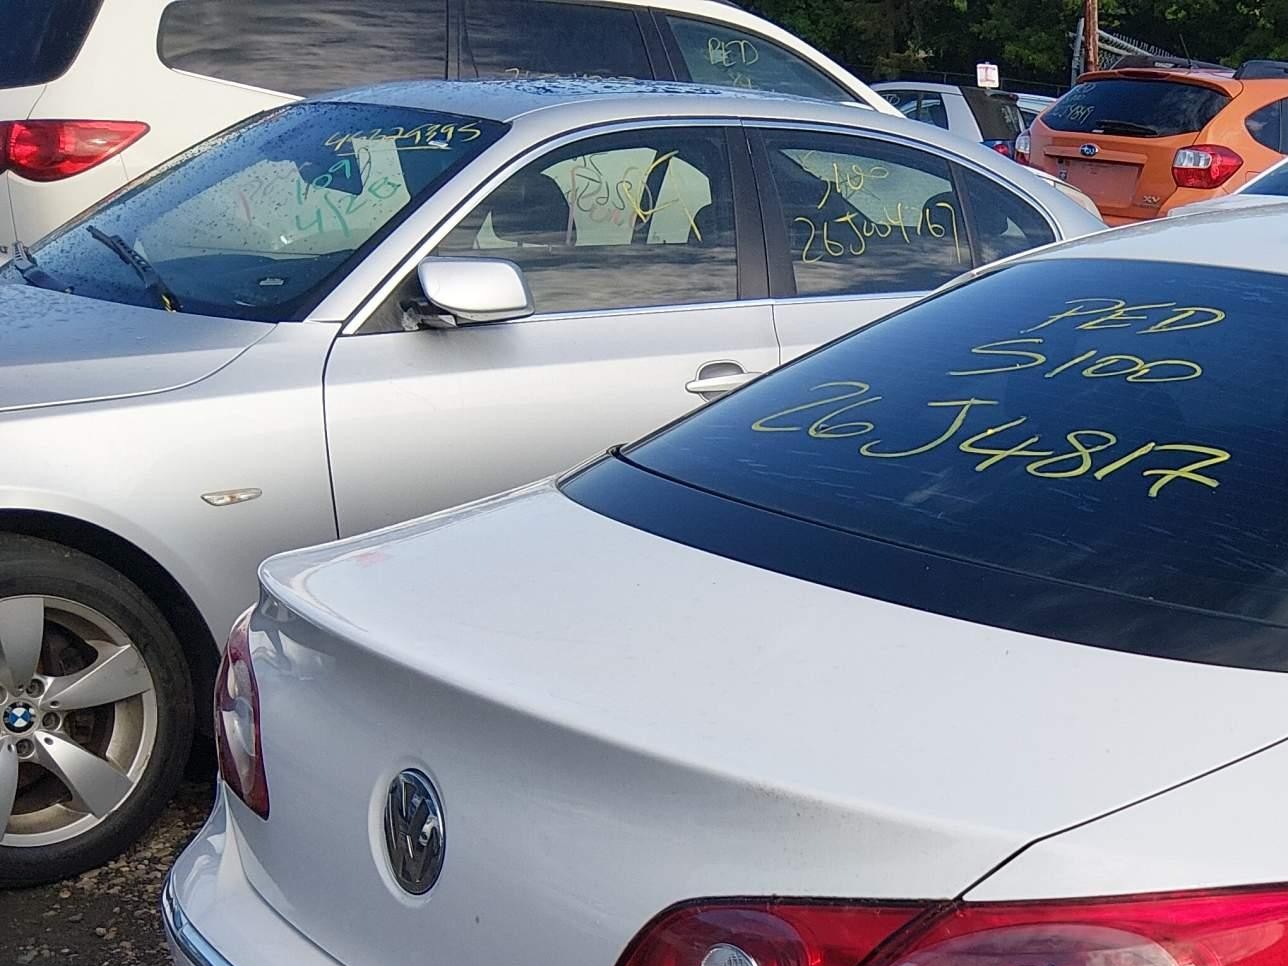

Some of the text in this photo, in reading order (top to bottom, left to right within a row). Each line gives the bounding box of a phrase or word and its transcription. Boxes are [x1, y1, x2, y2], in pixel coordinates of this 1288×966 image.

[708, 37, 759, 67] PED
[1019, 297, 1227, 335] PED
[946, 337, 1204, 384] S100
